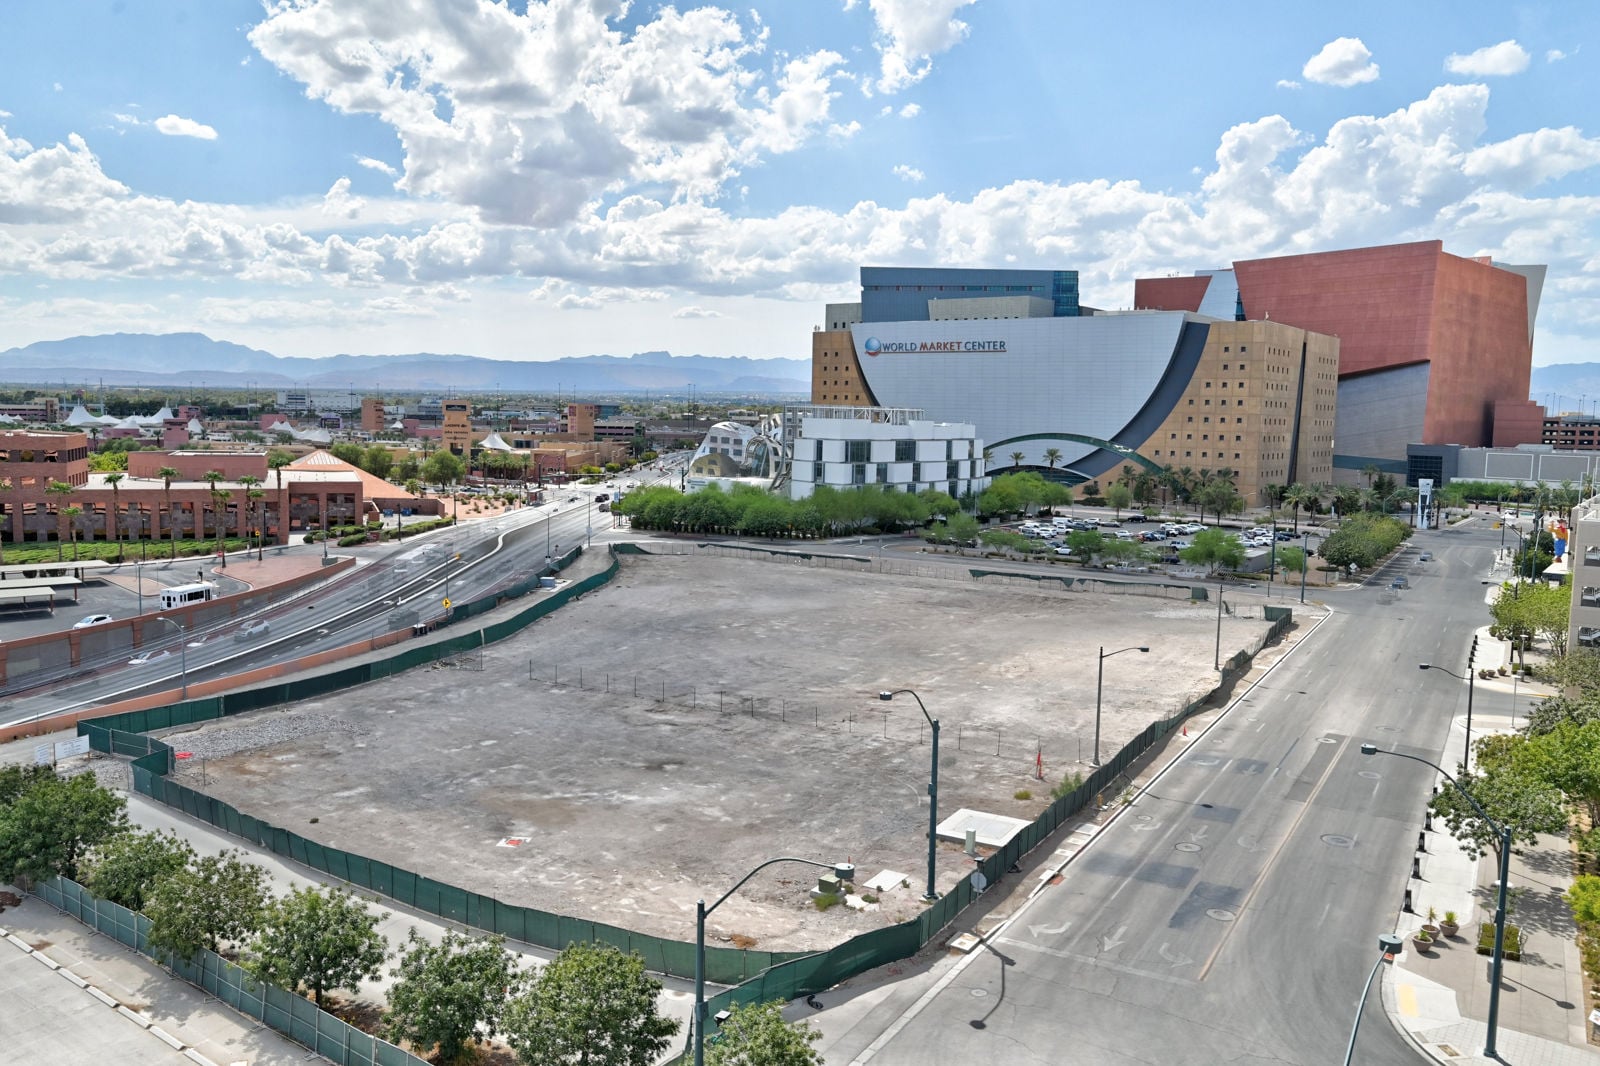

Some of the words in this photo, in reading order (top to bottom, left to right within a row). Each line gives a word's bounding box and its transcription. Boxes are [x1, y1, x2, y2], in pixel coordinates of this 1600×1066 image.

[882, 342, 917, 352] WORLD
[919, 341, 962, 351] MARKET
[964, 340, 1007, 351] CENTER
